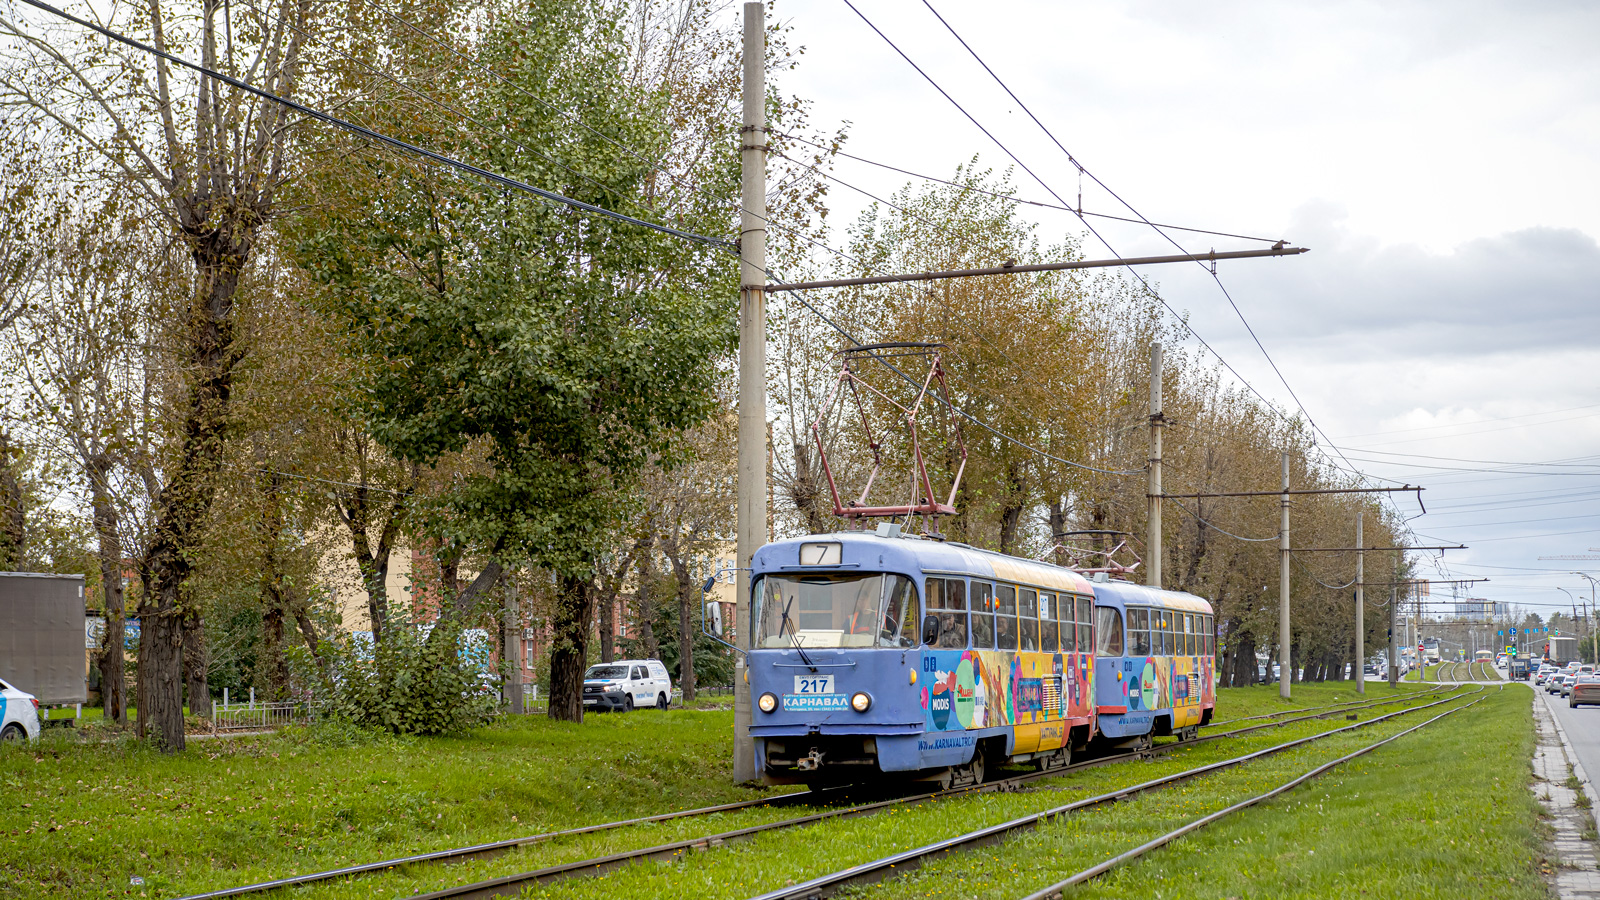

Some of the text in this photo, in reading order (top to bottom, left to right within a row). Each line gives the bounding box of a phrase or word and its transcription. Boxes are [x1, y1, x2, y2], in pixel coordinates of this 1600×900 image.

[816, 545, 829, 565] 7
[800, 679, 828, 693] 217
[783, 698, 849, 706] КАРНАВАЛ
[932, 698, 950, 711] MODIS
